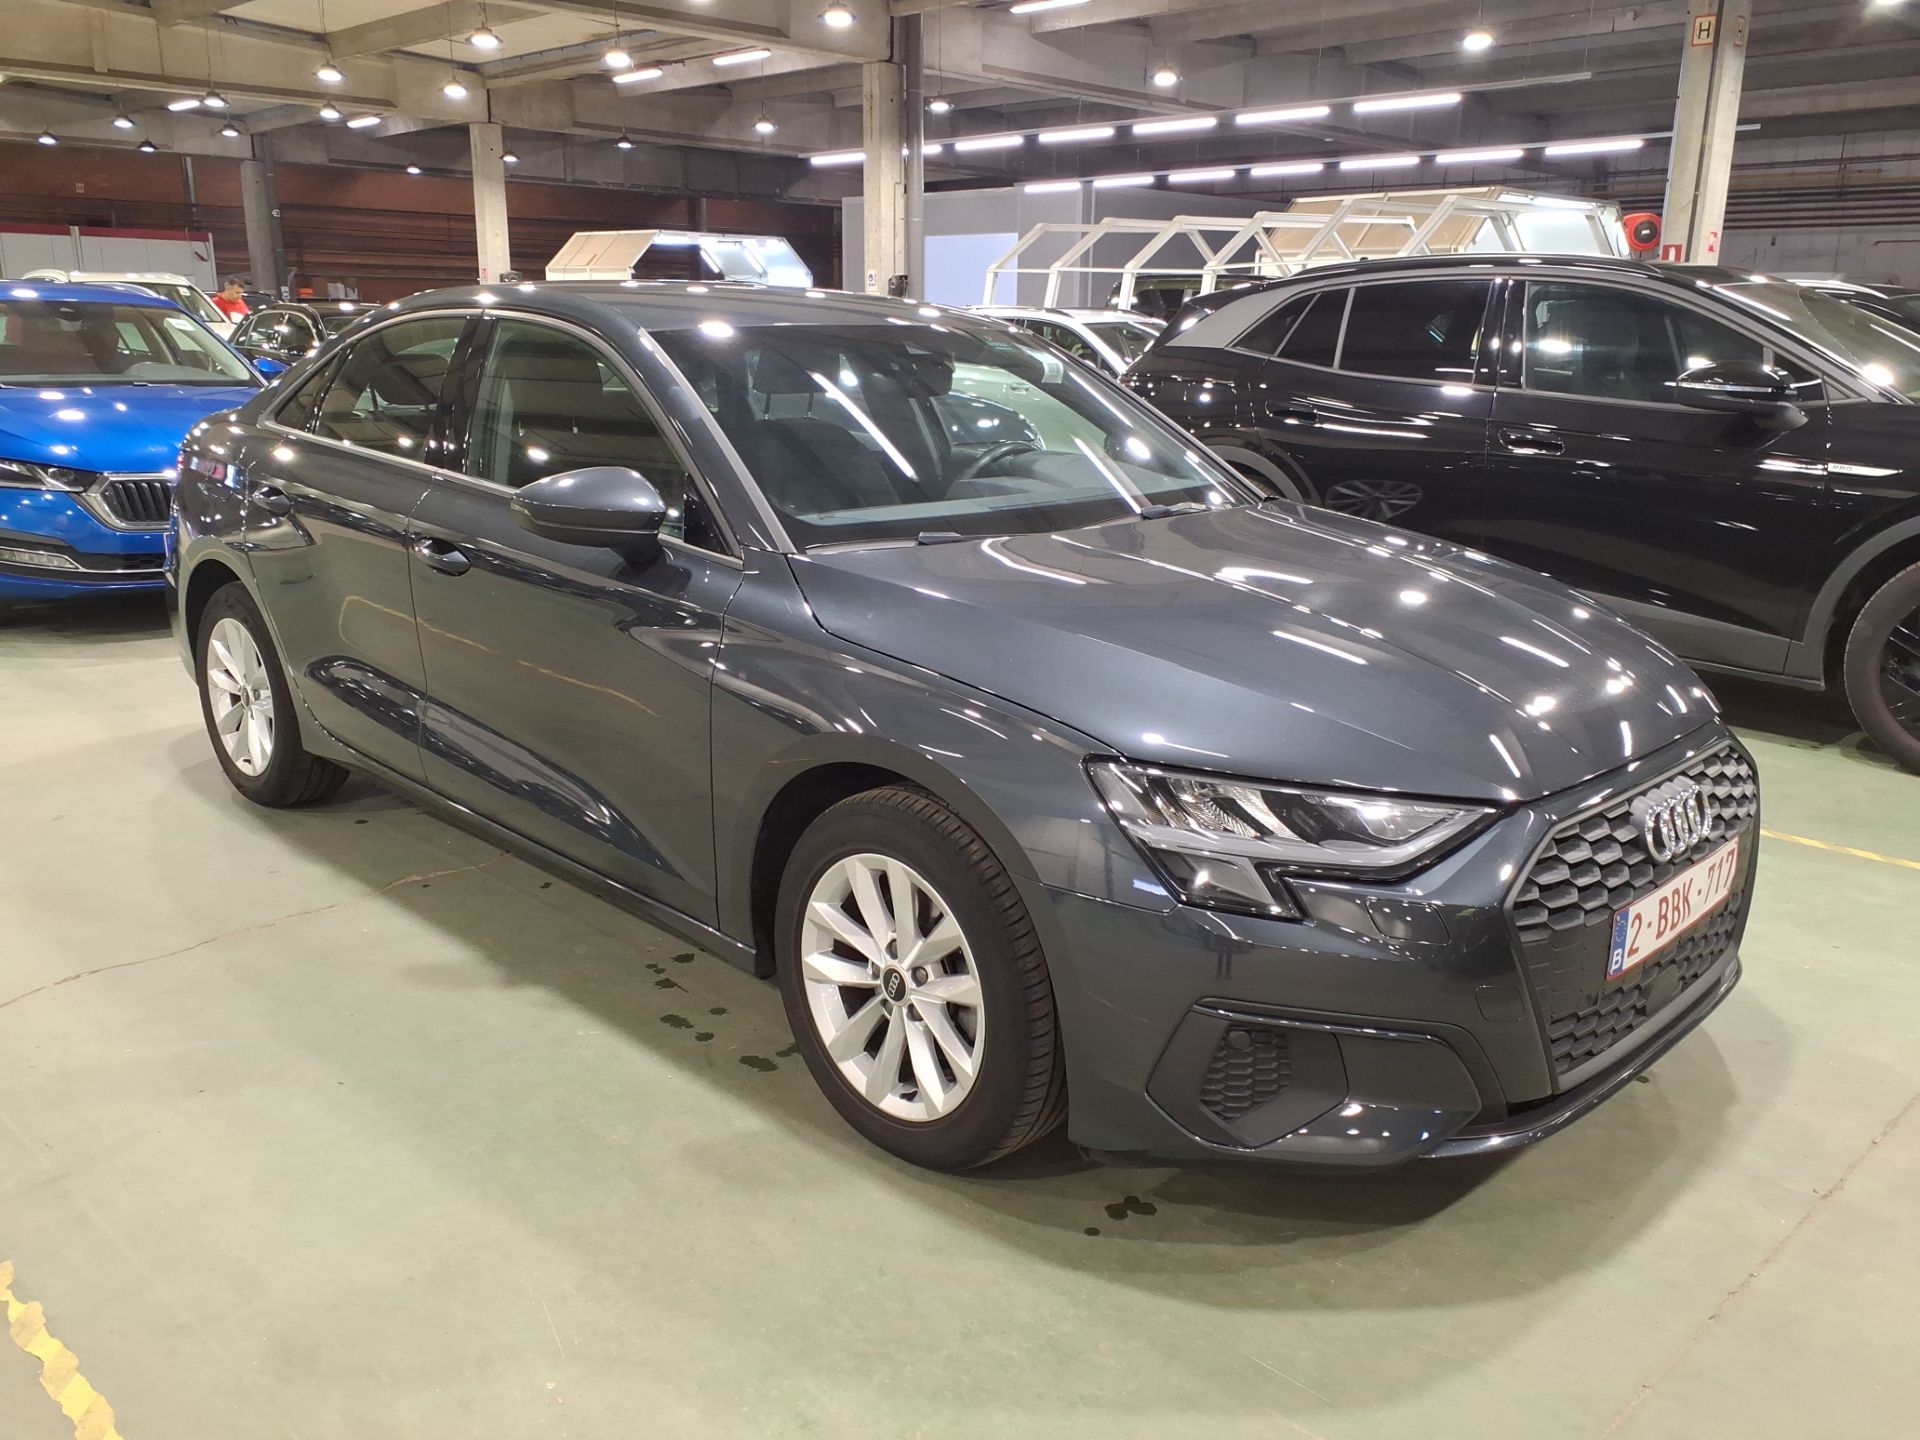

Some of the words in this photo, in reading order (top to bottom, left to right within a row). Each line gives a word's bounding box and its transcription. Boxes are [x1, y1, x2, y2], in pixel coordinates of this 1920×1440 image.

[1698, 21, 1711, 39] H
[1626, 847, 1736, 958] 2-BBK-717
[1612, 948, 1623, 970] B
